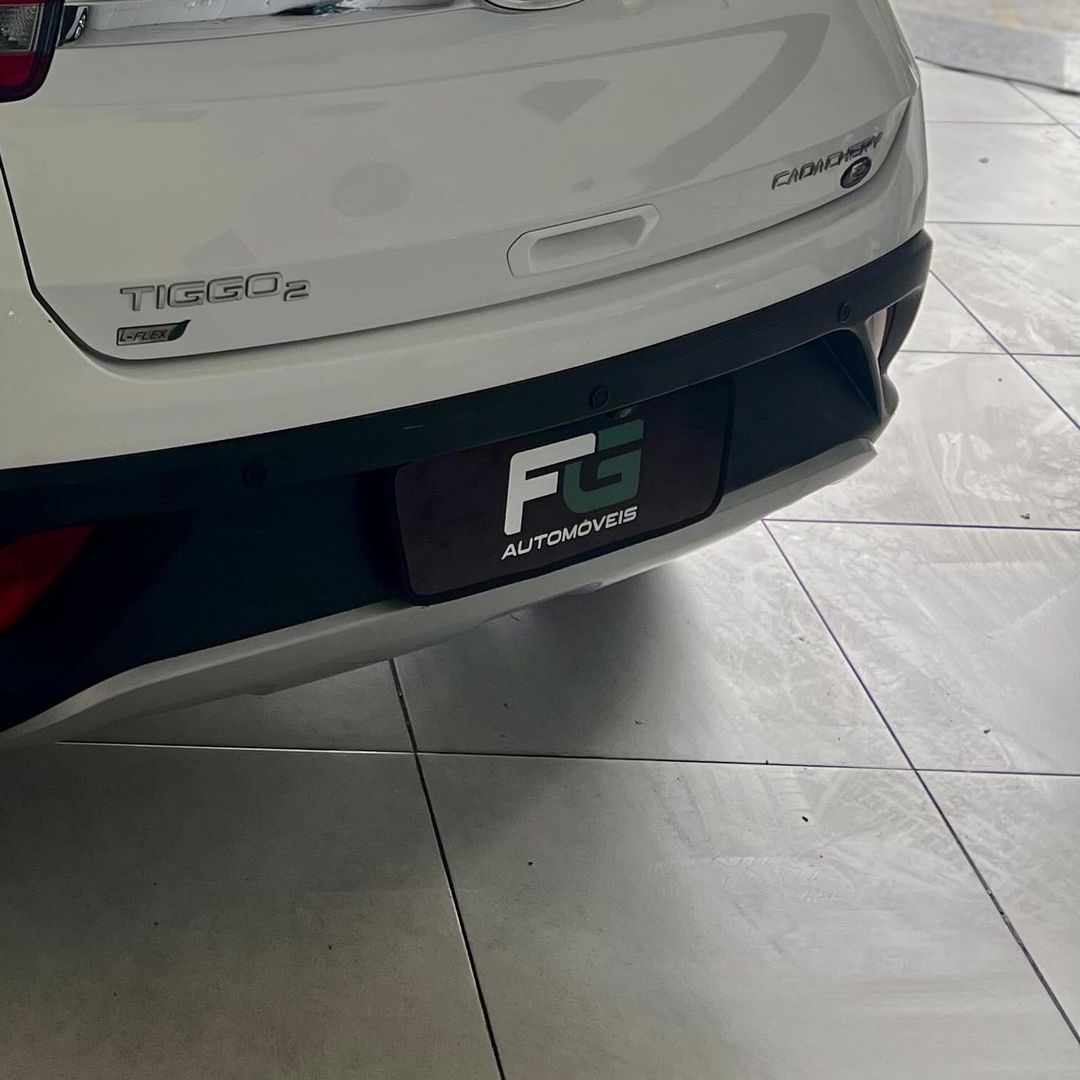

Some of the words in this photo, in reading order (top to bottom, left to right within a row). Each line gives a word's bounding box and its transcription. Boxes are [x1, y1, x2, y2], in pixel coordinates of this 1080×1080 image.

[119, 329, 169, 342] L-FLEX
[504, 419, 644, 536] FG
[501, 505, 638, 561] AUTOMÓVEIS
